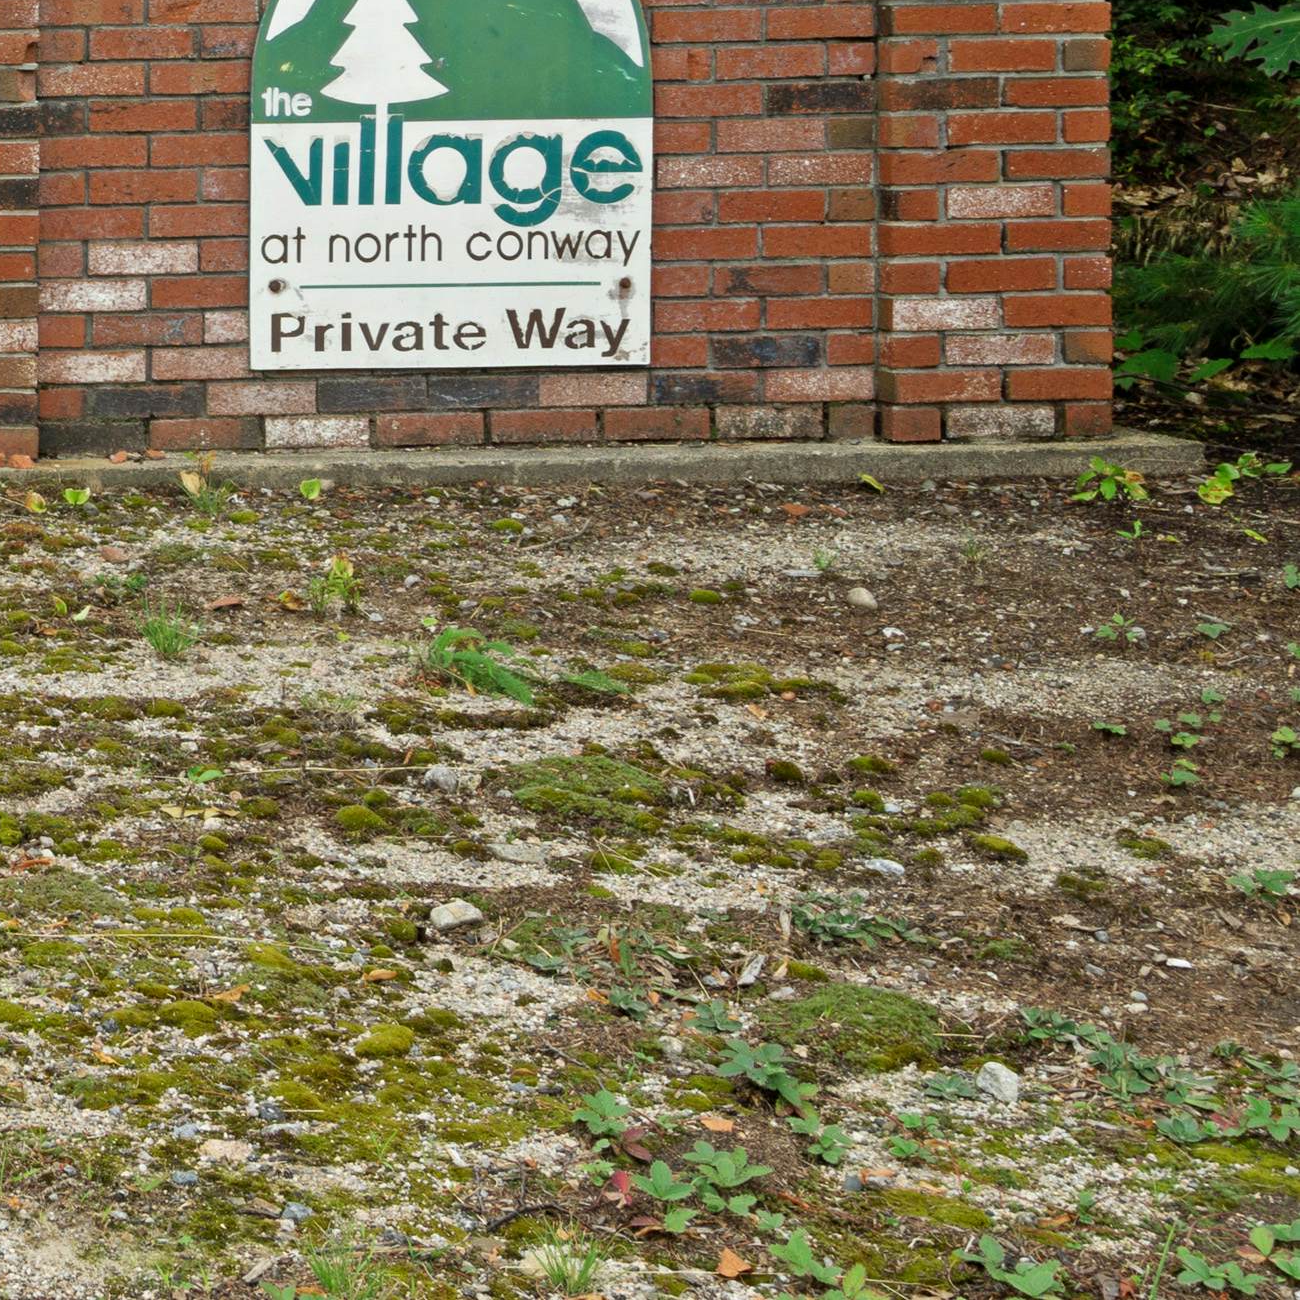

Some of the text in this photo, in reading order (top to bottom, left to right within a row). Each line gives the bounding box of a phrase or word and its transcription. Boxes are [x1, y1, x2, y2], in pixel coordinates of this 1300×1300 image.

[261, 87, 312, 117] the
[263, 114, 644, 227] village
[261, 224, 641, 267] at north conway
[270, 307, 630, 357] Private Way
